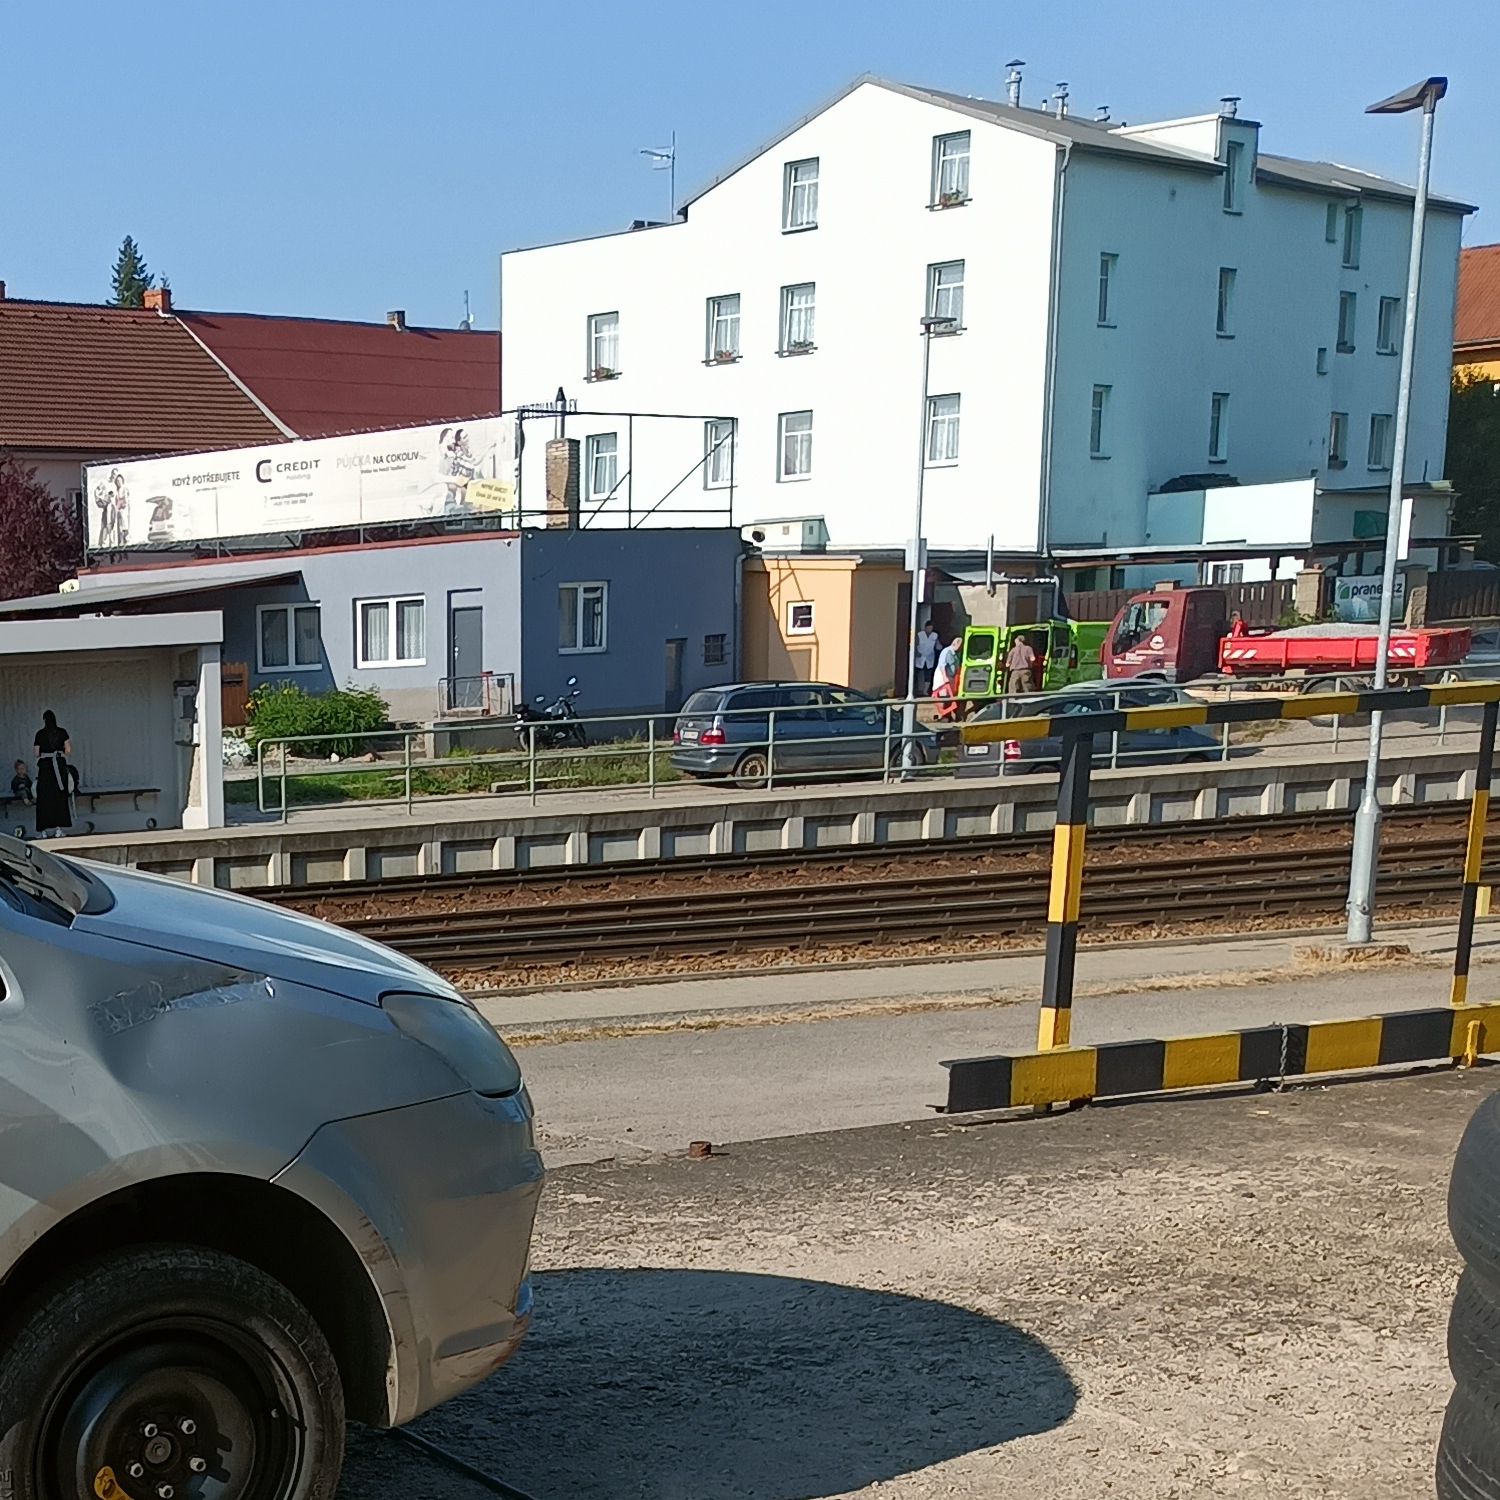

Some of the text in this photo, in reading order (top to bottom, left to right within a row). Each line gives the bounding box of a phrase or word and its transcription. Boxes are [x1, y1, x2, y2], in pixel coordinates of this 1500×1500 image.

[373, 456, 384, 464] NA
[386, 451, 419, 463] COKOLIV
[276, 459, 320, 473] CREDIT
[172, 471, 241, 487] KDYŽ POTŘEBUJETE
